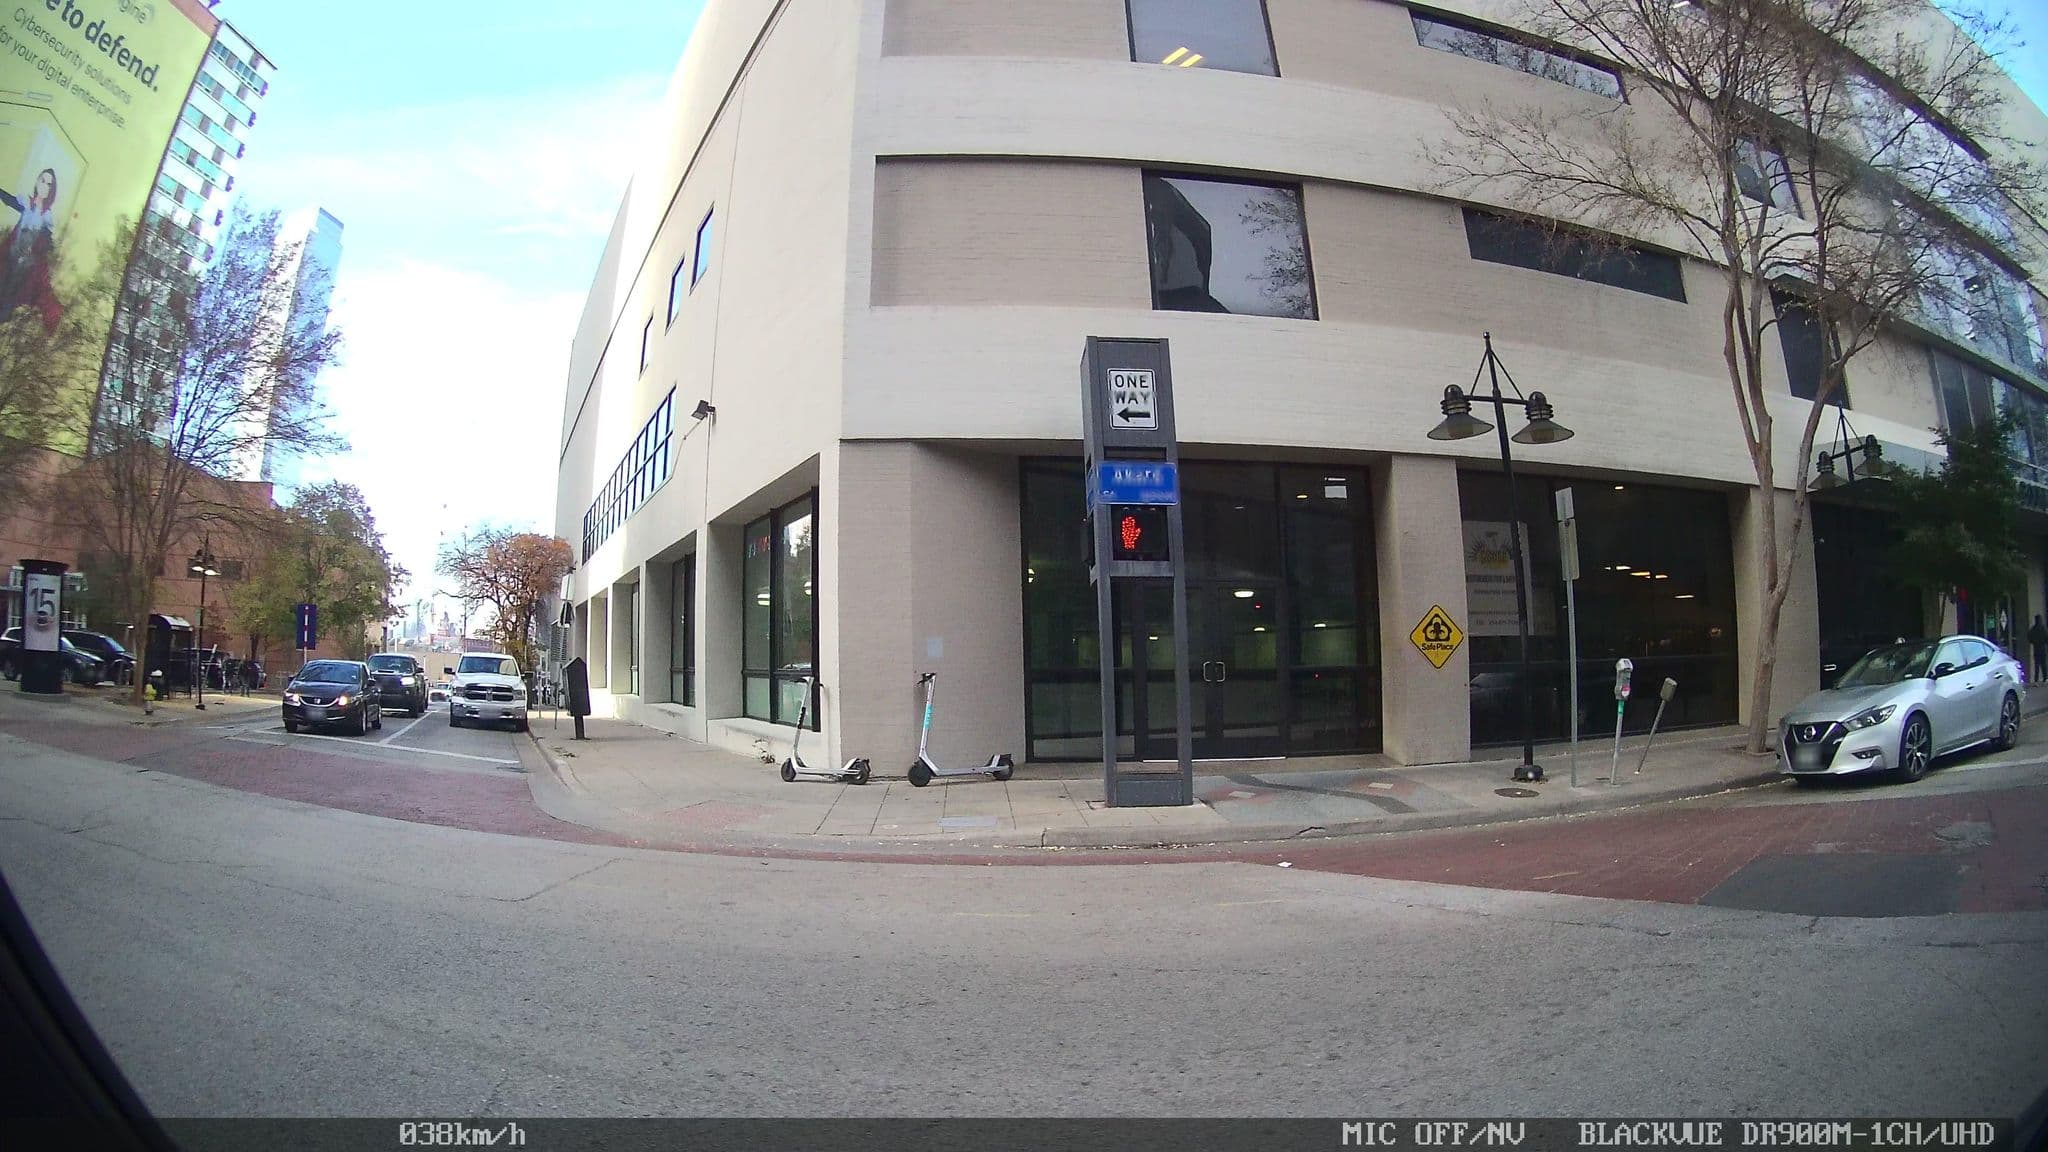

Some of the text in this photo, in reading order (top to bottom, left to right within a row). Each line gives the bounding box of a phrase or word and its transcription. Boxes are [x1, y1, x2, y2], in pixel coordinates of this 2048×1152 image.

[14, 7, 132, 104] Cybersecurity solutions
[61, 0, 84, 29] to
[85, 19, 160, 92] defend.
[10, 38, 38, 64] your
[37, 56, 71, 90] digital
[1115, 374, 1148, 388] ONE
[1114, 391, 1150, 405] WAY
[30, 587, 56, 618] 15
[1421, 642, 1436, 651] Safe
